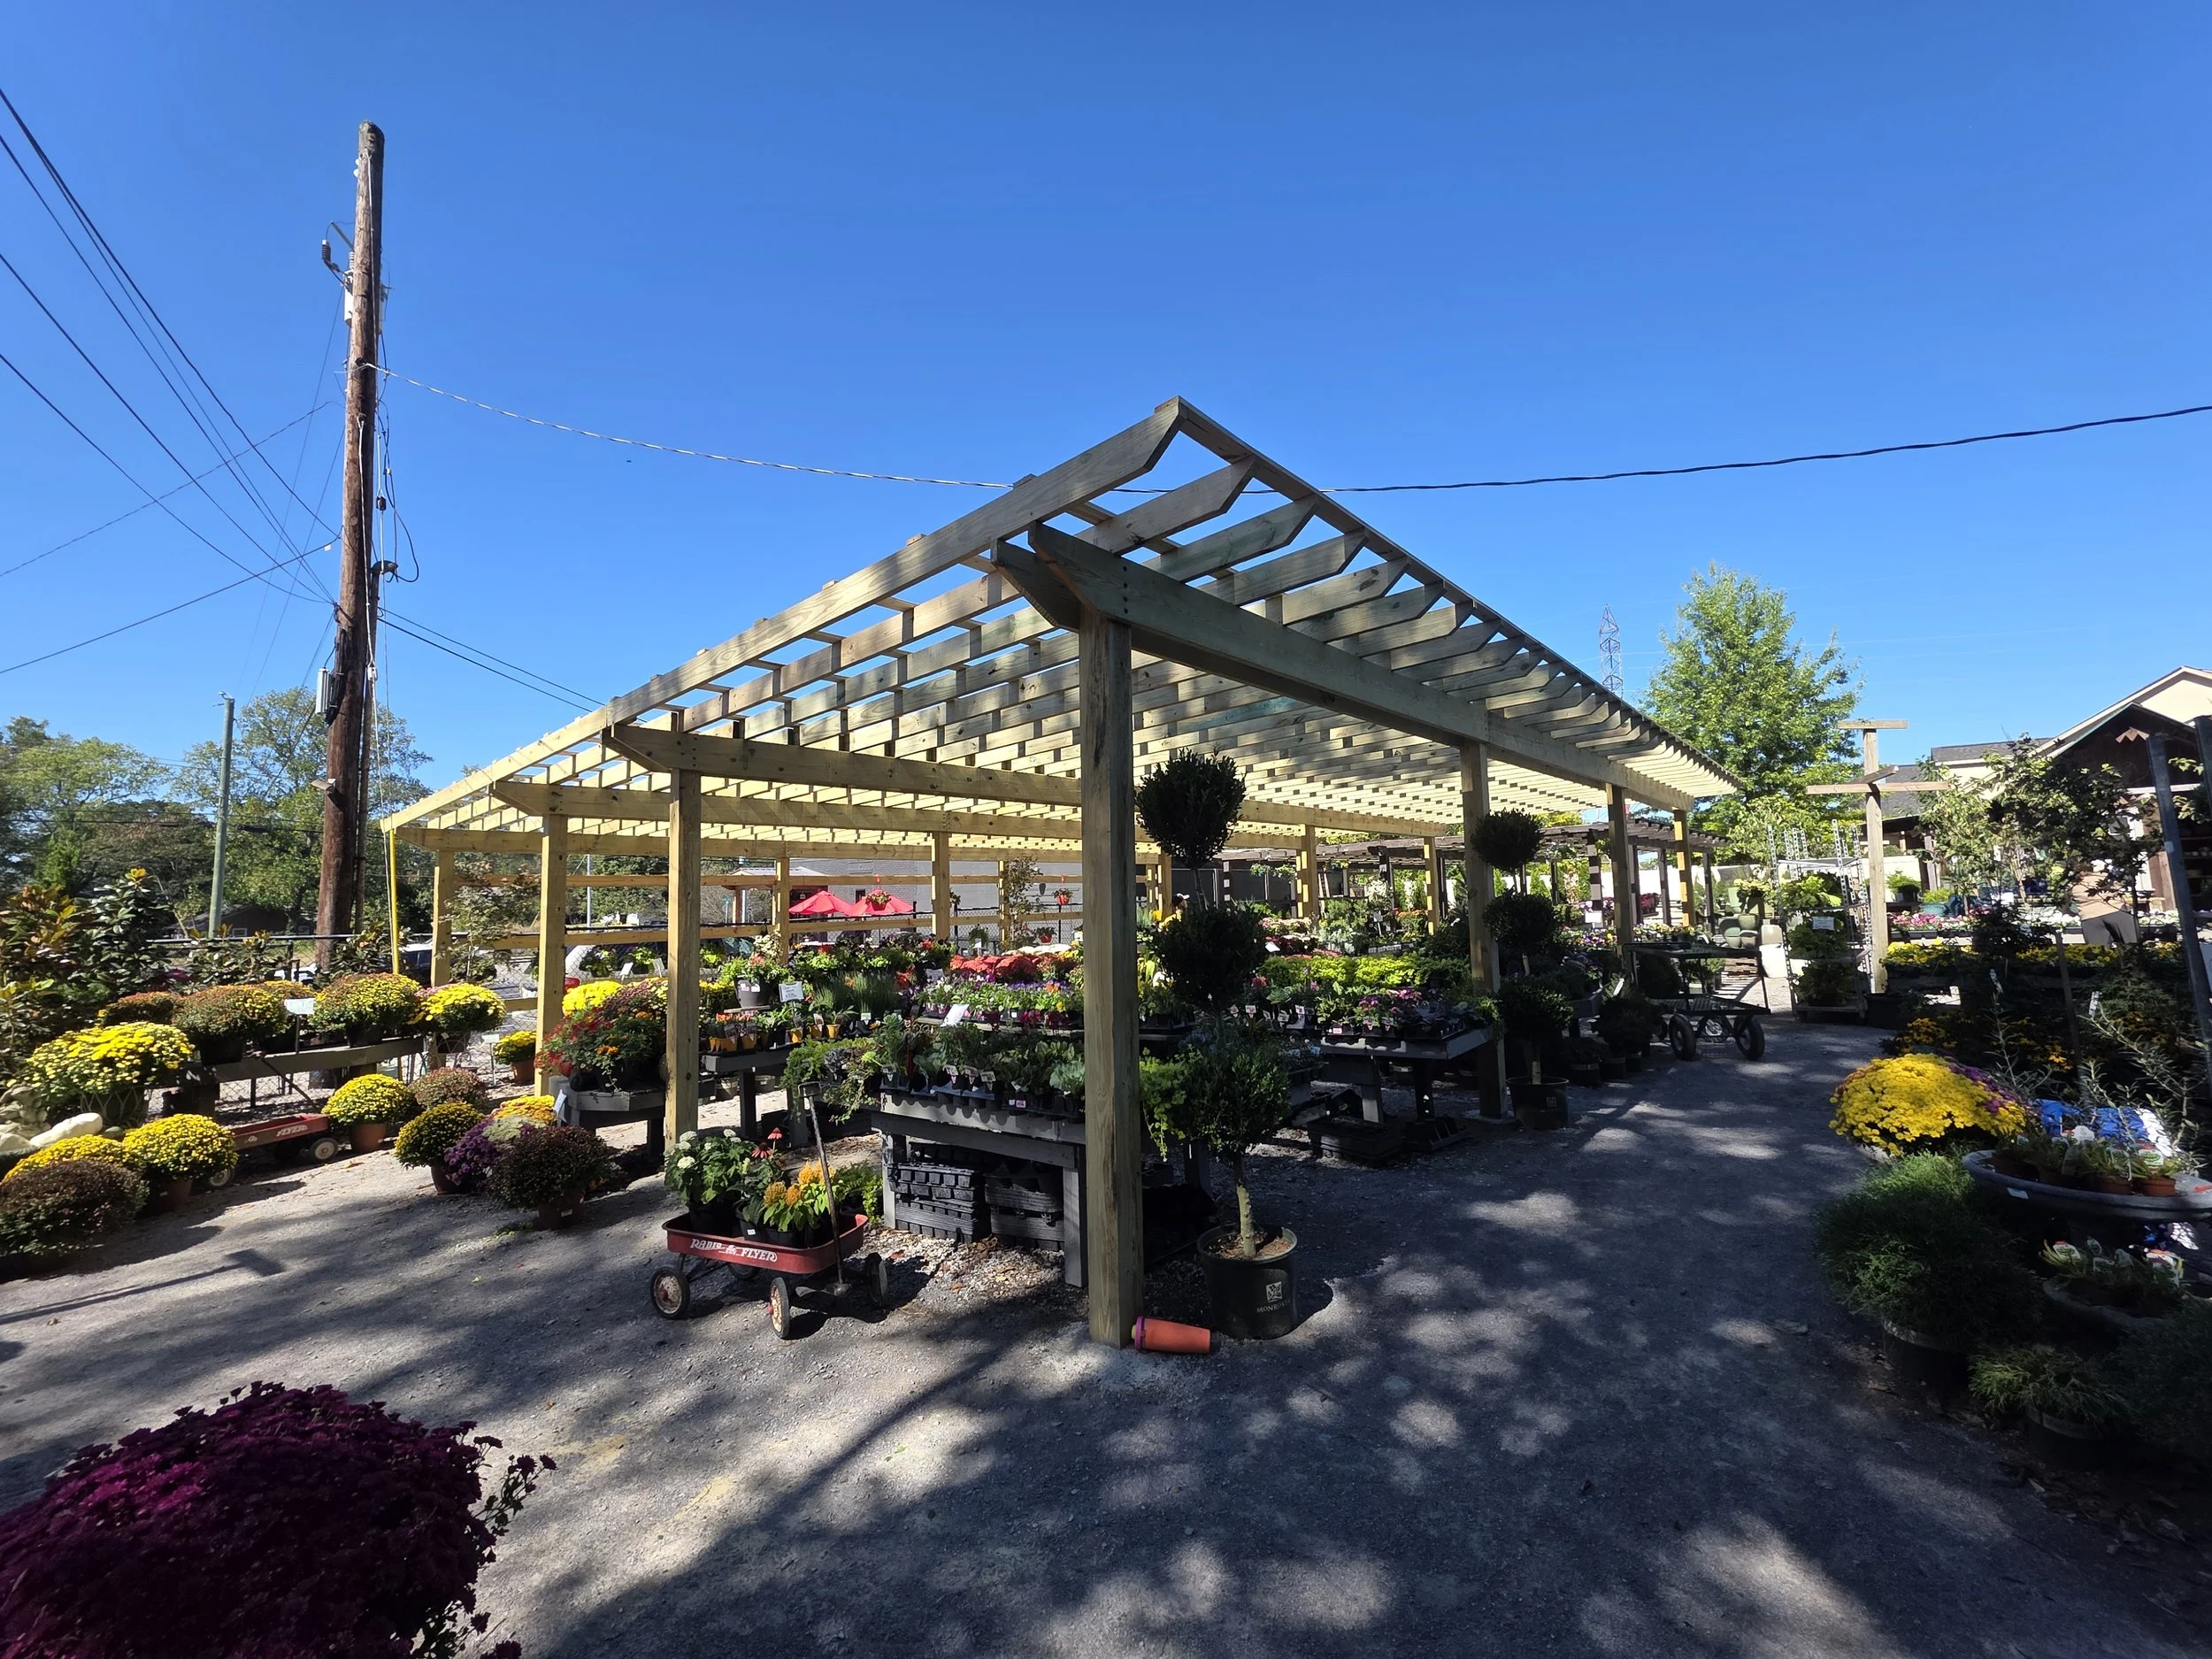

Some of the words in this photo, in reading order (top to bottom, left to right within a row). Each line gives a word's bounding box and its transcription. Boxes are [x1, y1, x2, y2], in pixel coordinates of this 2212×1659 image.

[277, 1125, 308, 1136] FLYER
[690, 1239, 723, 1250] RADIO
[741, 1248, 778, 1262] FLYER
